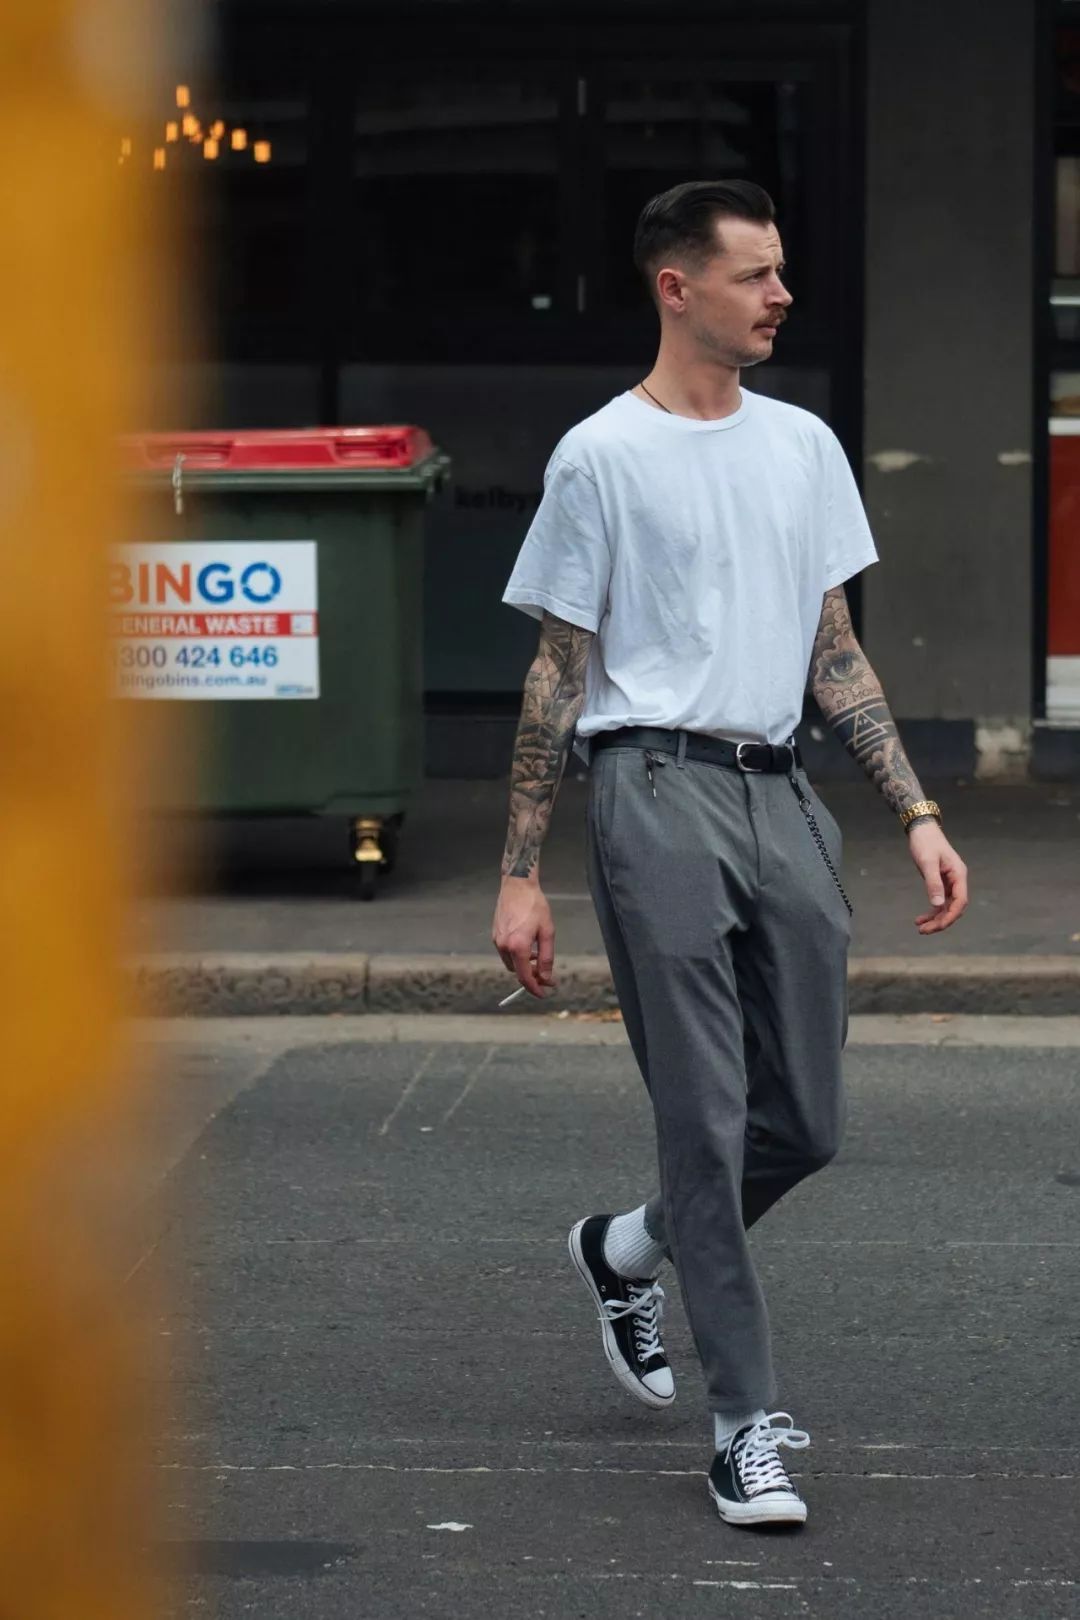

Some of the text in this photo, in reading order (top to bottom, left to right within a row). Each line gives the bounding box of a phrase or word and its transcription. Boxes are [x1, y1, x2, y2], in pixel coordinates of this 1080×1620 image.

[107, 562, 282, 604] BINGO
[120, 615, 278, 635] ENERAL WASTE
[175, 645, 221, 668] 424
[230, 645, 278, 668] 646
